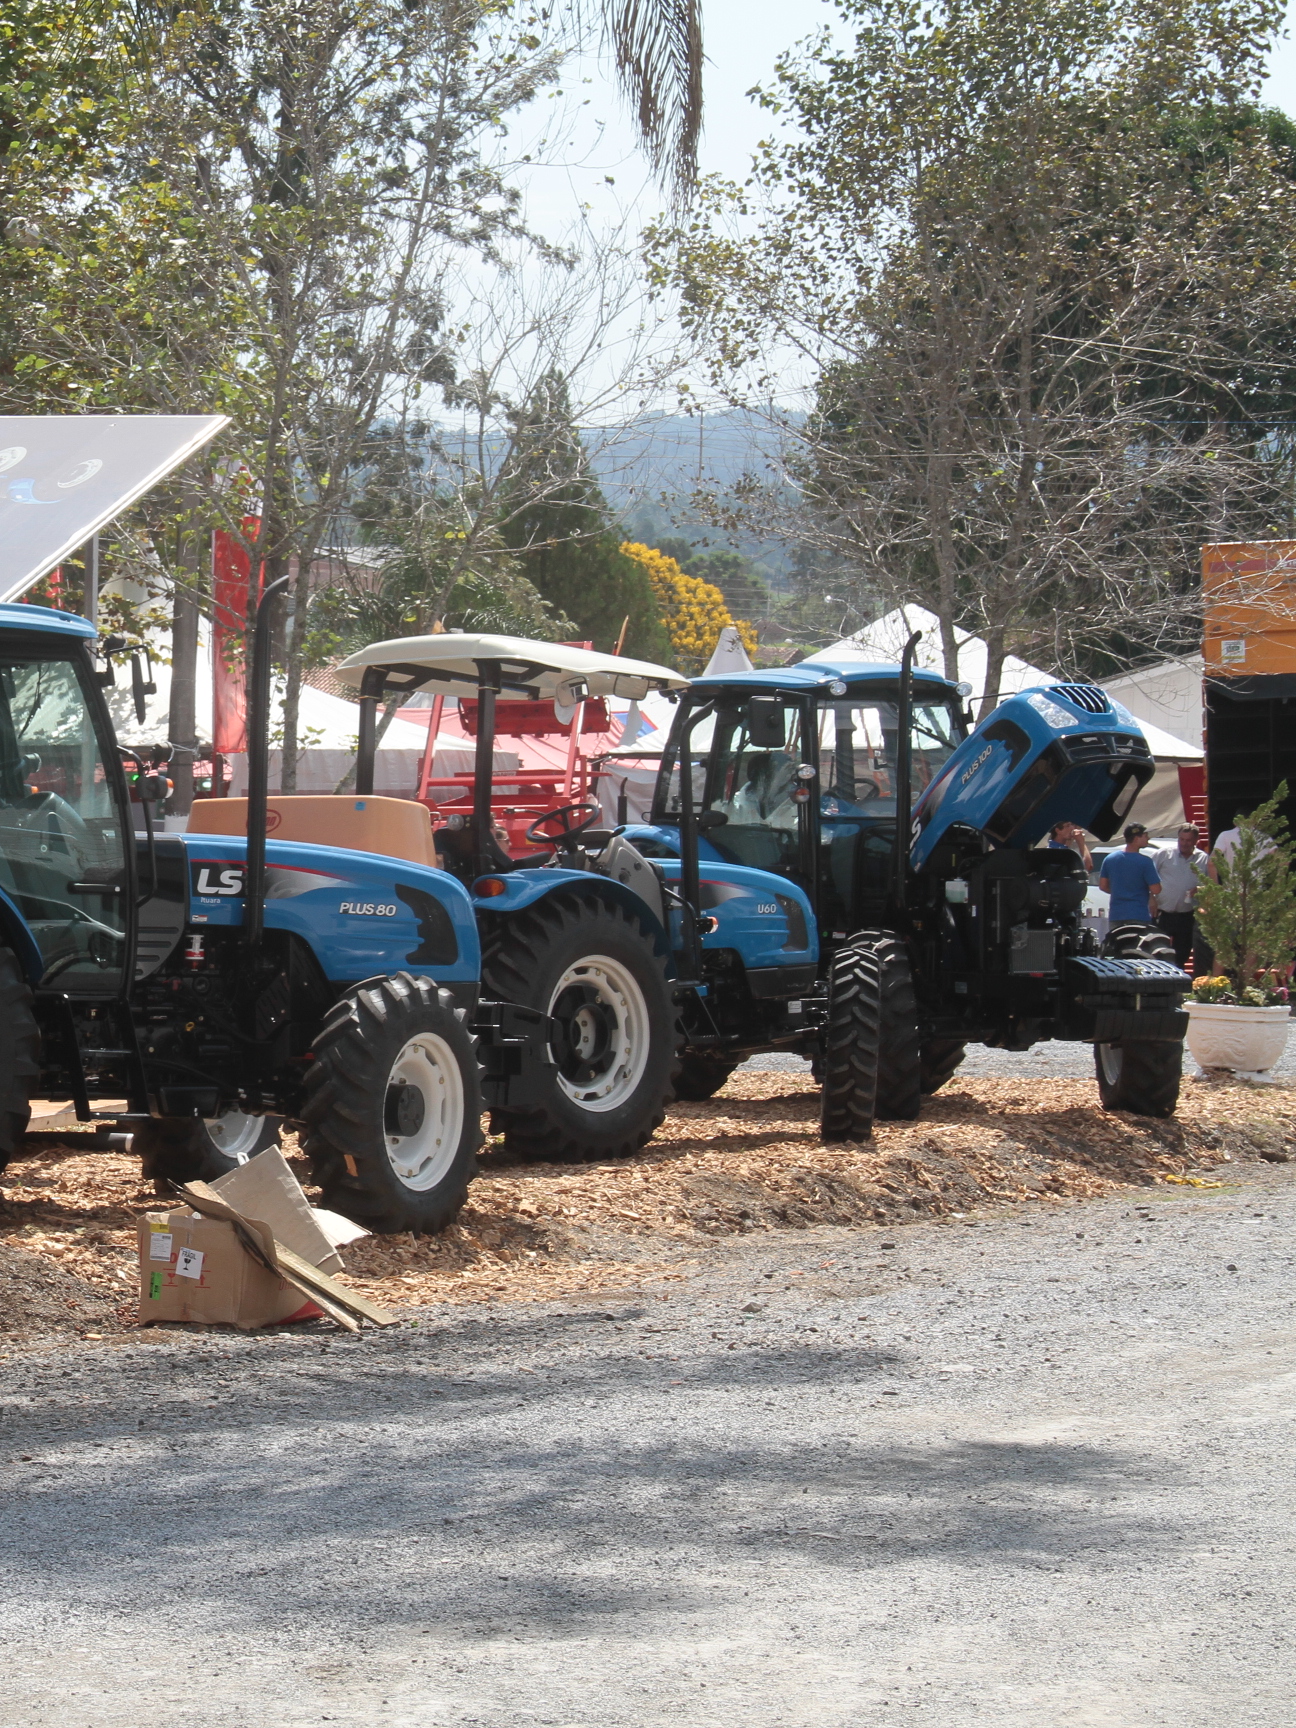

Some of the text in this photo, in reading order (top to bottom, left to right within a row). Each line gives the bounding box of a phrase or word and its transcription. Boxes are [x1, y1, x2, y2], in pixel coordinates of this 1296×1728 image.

[961, 744, 993, 785] PLUS 100
[197, 868, 243, 895] LS
[339, 902, 397, 916] PLUS 80
[757, 903, 777, 914] U60
